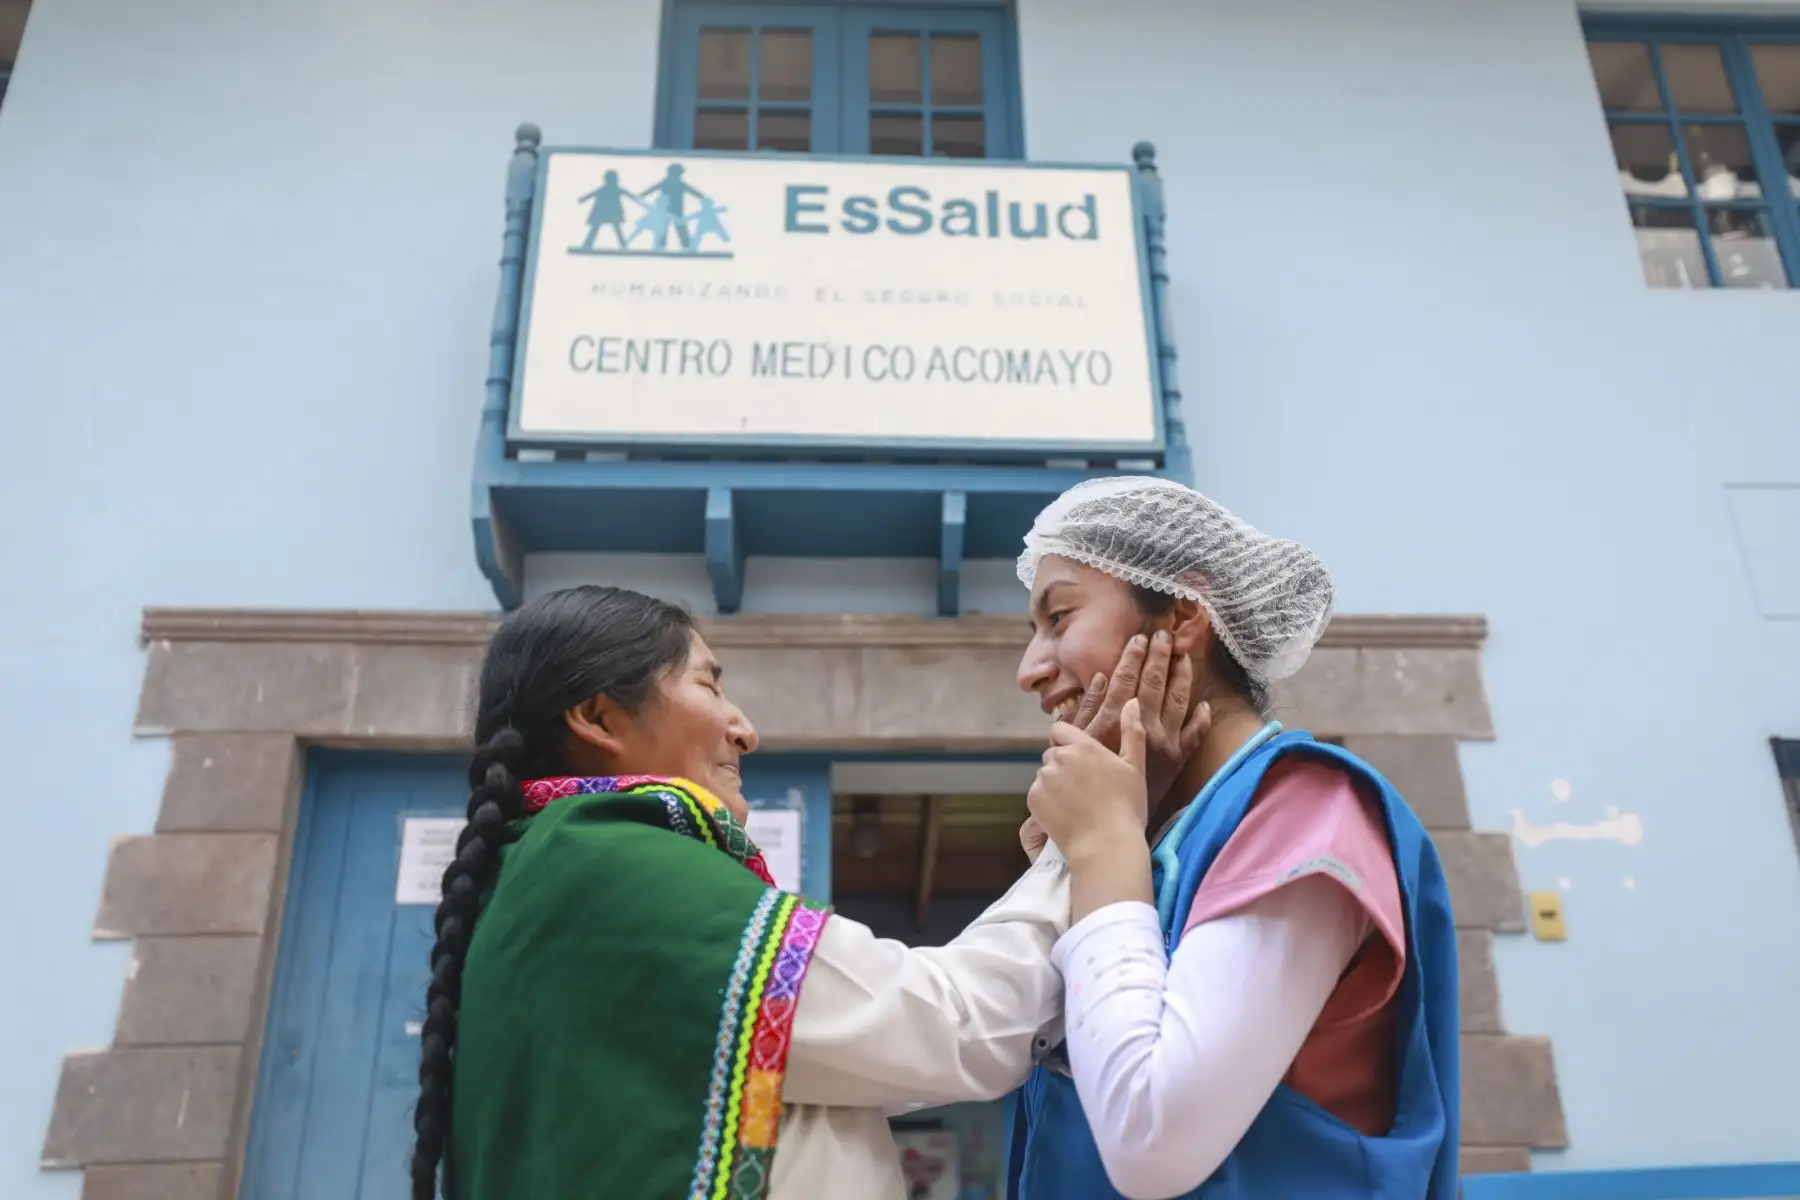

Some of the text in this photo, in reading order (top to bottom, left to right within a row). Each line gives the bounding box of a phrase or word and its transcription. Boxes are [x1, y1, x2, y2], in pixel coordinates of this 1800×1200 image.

[784, 183, 1099, 241] EsSalud
[568, 334, 1113, 387] CENTRO MEDICO ACOMAYO
